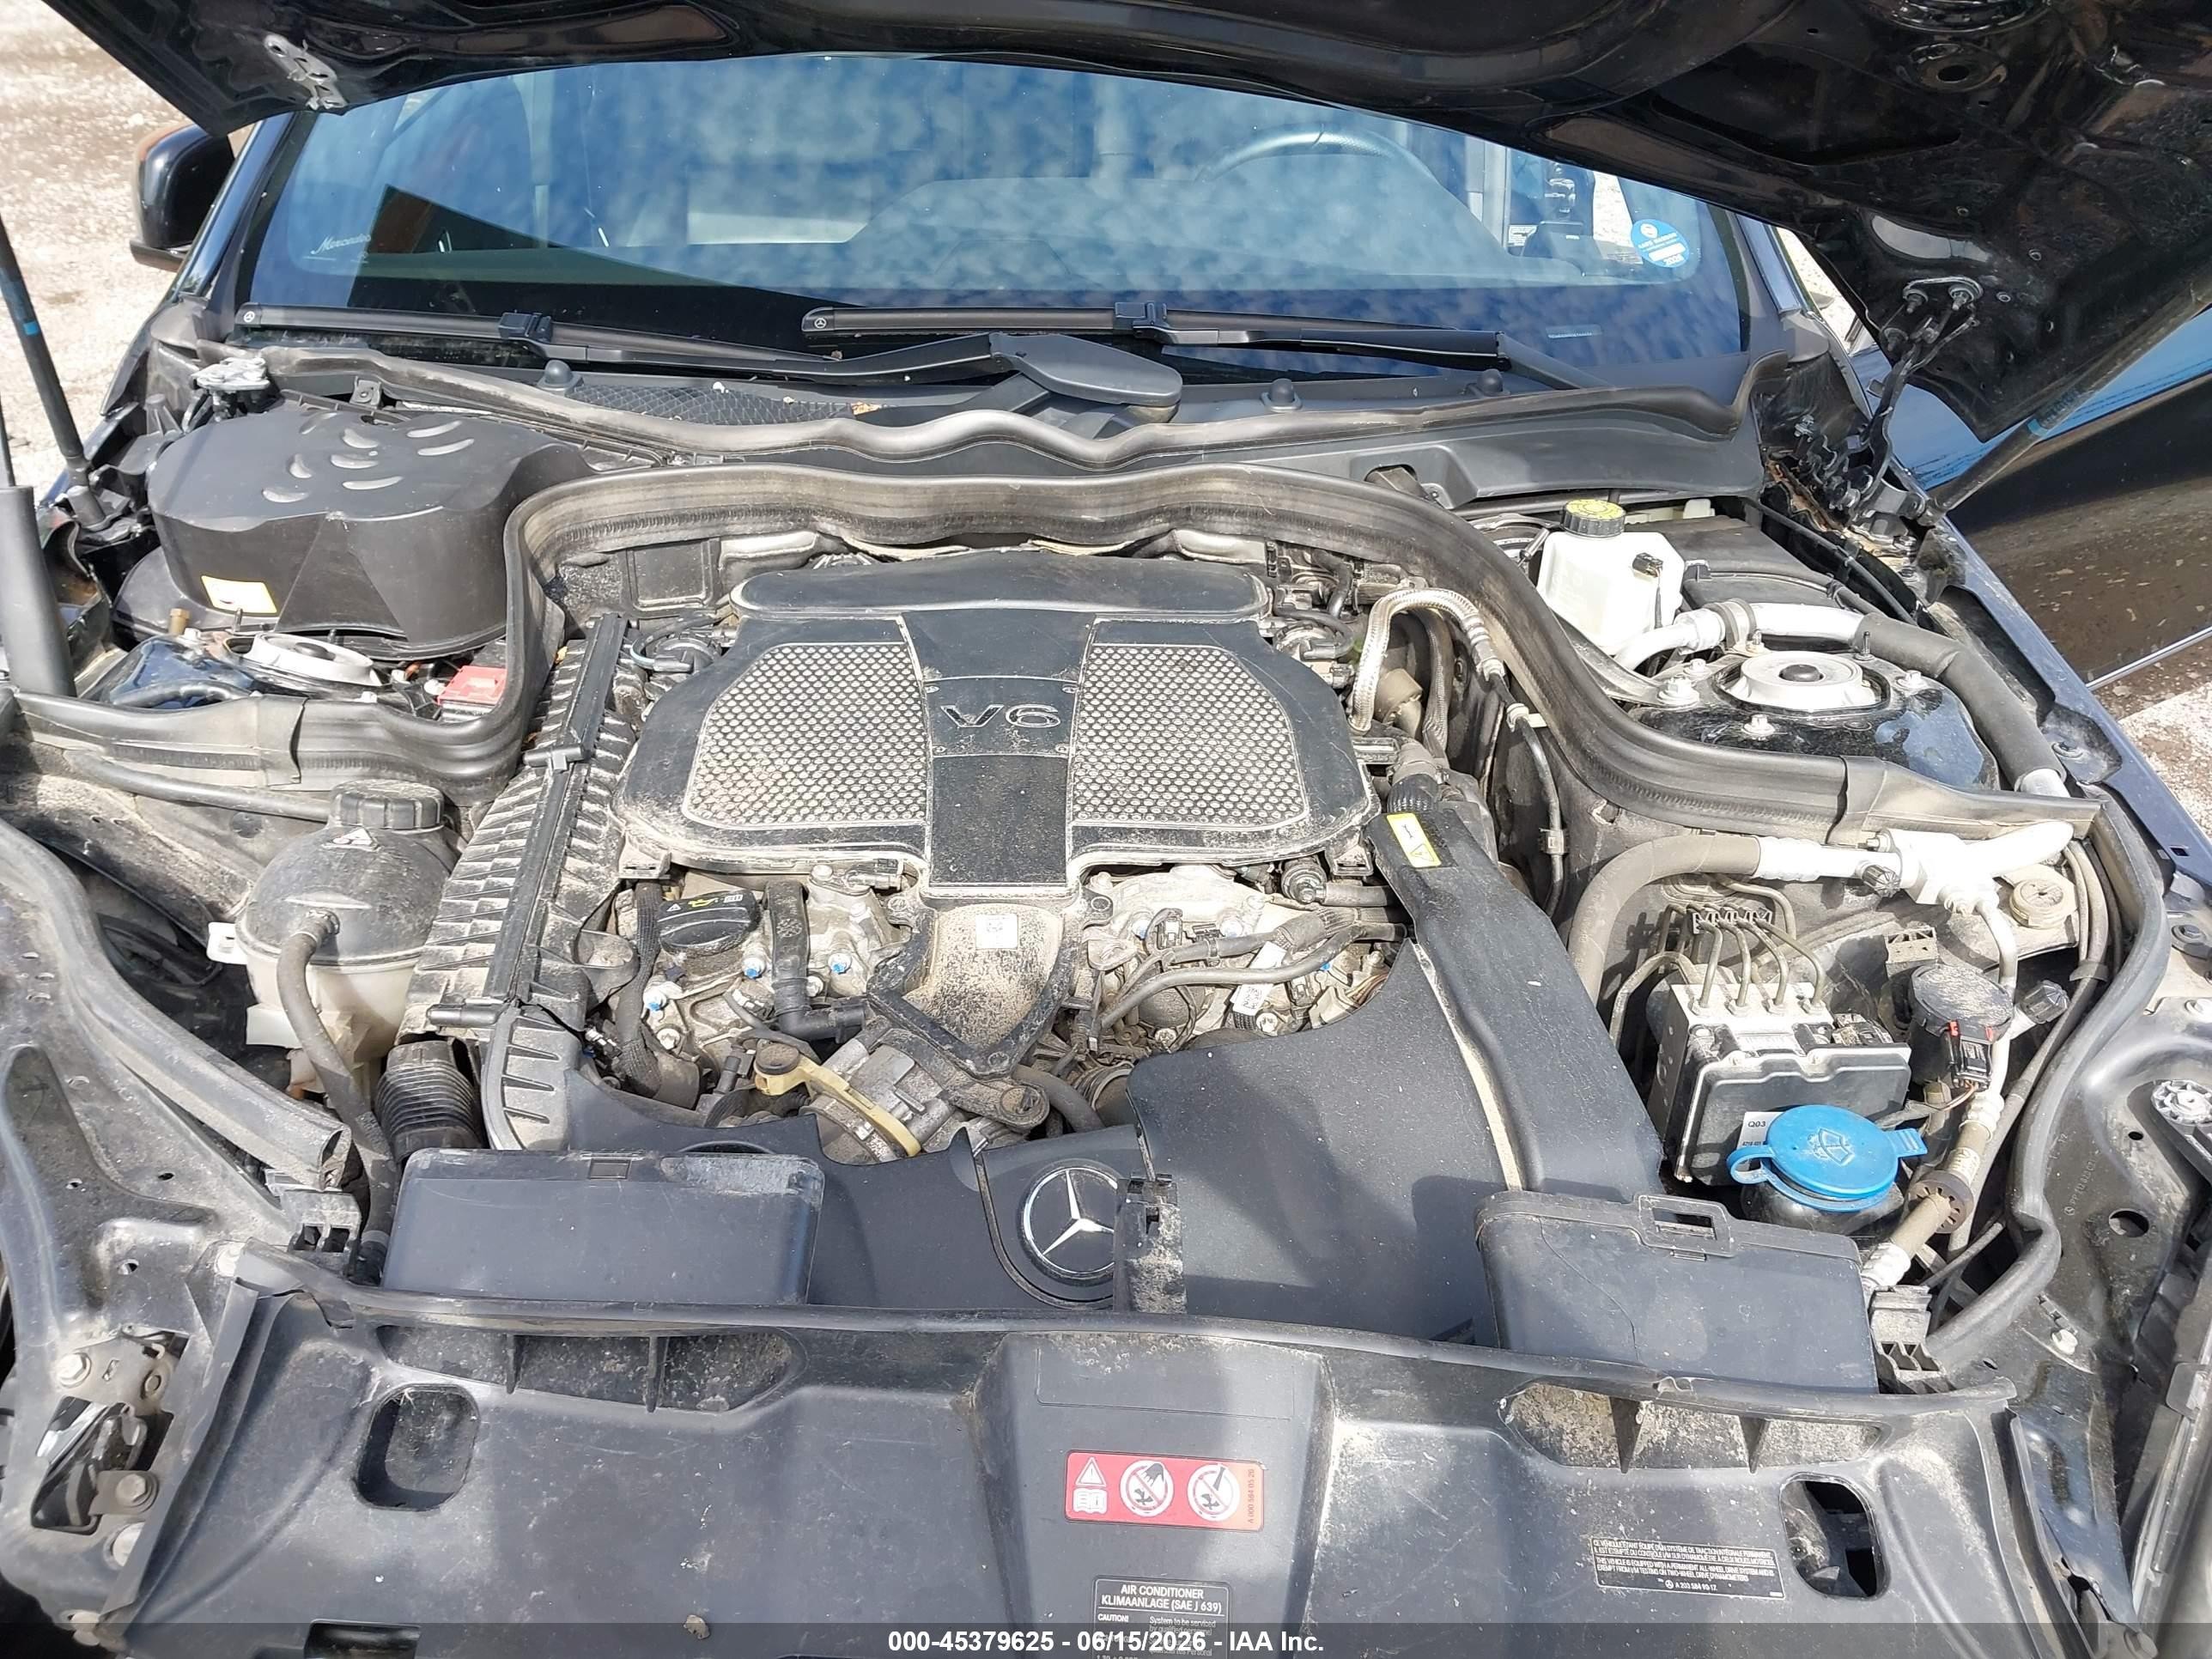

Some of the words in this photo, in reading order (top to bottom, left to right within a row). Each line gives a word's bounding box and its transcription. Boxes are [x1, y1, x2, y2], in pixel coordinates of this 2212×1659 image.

[940, 704, 1061, 728] V6
[1667, 1569, 1695, 1577] TWO-WHEEL
[1121, 1584, 1136, 1595] AIR
[1139, 1585, 1204, 1599] CONDITIONER
[1101, 1595, 1170, 1609] KLIMAANLAGE
[1171, 1600, 1192, 1611] (SAE
[1194, 1601, 1198, 1611] J
[1200, 1601, 1221, 1614] 639)
[1098, 1613, 1129, 1622] CAUTION!
[1149, 1616, 1173, 1626] System
[1174, 1617, 1180, 1625] to
[1181, 1618, 1189, 1626] be
[1191, 1619, 1215, 1628] serviced
